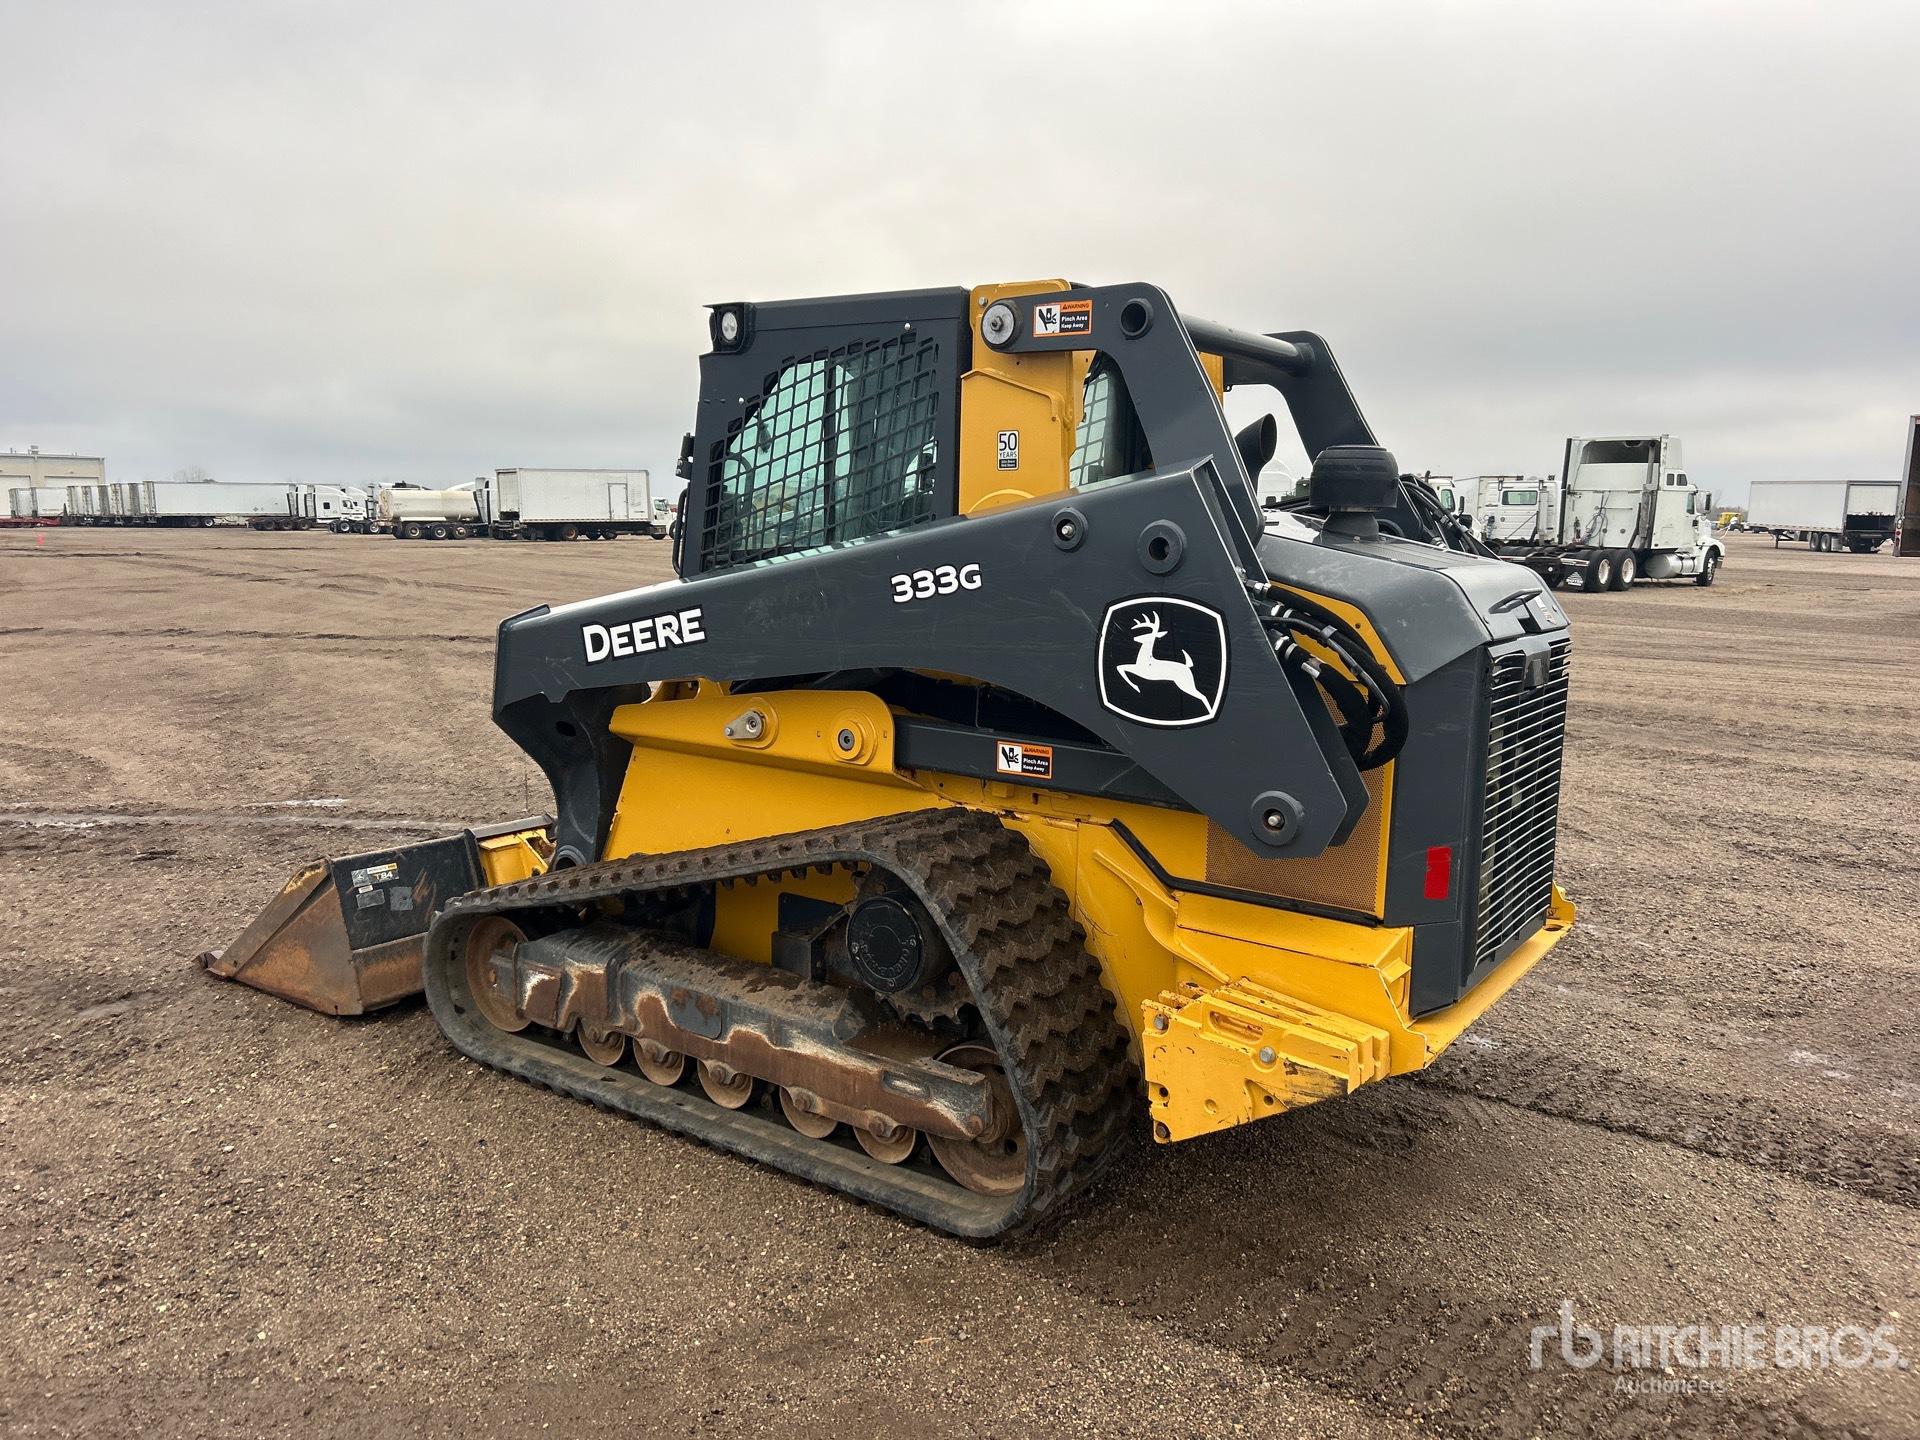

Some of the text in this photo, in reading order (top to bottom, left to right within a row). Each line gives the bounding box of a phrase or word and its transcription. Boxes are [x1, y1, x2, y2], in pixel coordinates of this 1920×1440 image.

[999, 432, 1017, 451] 50
[890, 563, 982, 603] 333G
[582, 608, 706, 663] DEERE
